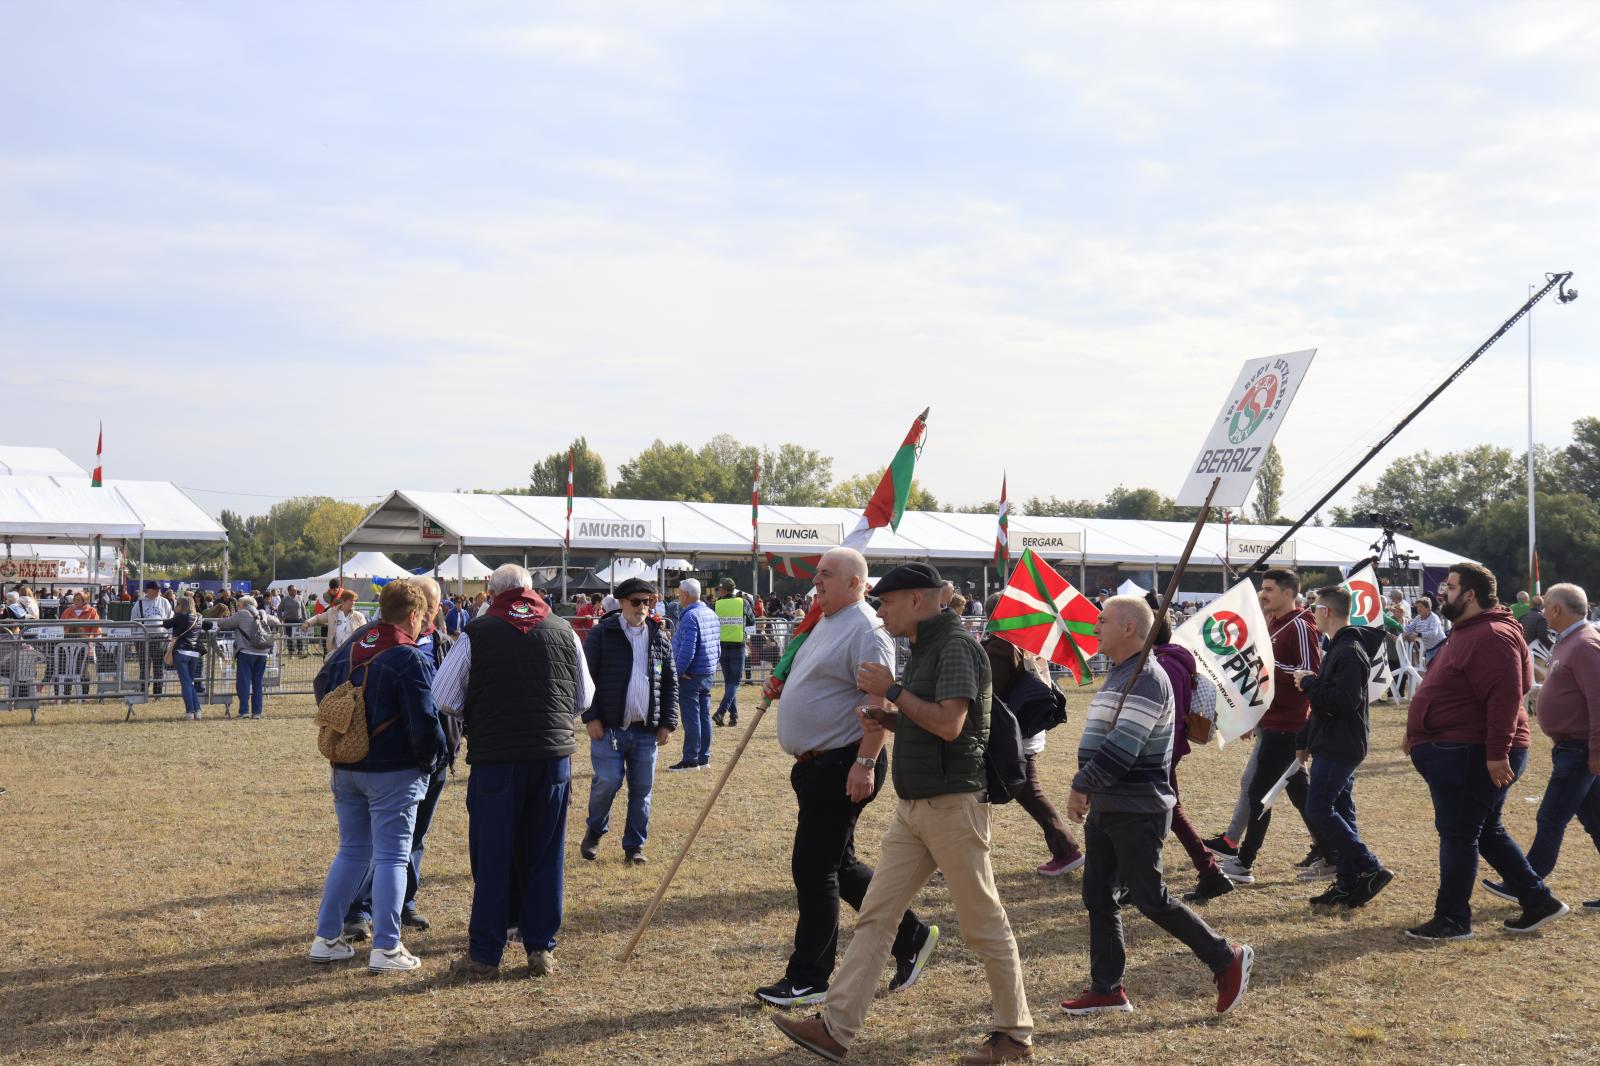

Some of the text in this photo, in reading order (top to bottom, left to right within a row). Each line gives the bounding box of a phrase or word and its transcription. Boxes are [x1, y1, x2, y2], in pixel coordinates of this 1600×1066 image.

[1195, 447, 1262, 474] BERRIZ
[578, 522, 646, 540] AMURRIO
[775, 528, 819, 540] MUNGIA
[1022, 536, 1064, 547] BERGARA
[1238, 543, 1283, 555] SANTURZI
[1239, 642, 1270, 687] EAJ
[1193, 648, 1236, 709] www.eaj-pnv.eu
[1221, 653, 1265, 708] PNV
